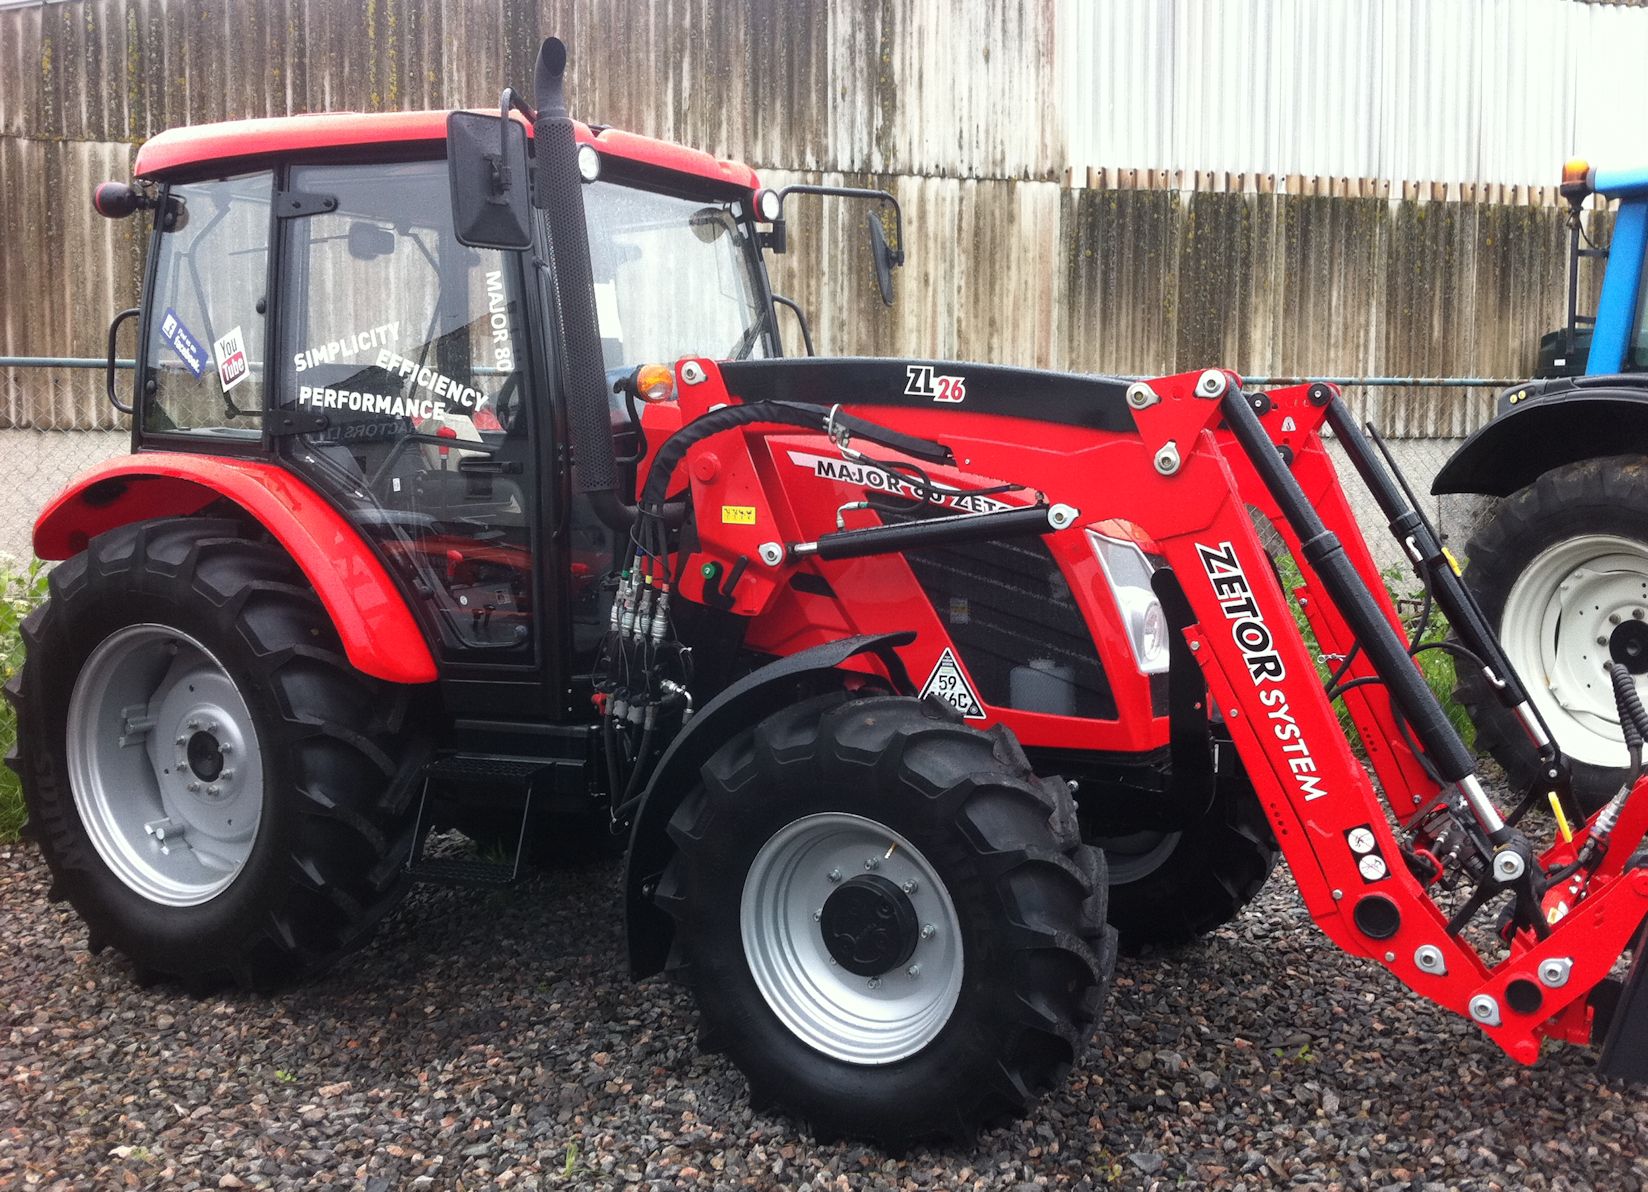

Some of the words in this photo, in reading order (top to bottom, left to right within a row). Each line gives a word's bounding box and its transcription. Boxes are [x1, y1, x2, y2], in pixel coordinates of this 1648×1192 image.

[486, 270, 509, 344] MAJOR
[220, 338, 237, 358] You
[293, 321, 400, 372] SIMPLICITY
[494, 347, 513, 373] 80
[222, 357, 245, 381] Tube
[375, 347, 489, 411] EFFICIENCY
[299, 386, 446, 421] PERFORMANCE
[816, 461, 903, 493] MAJOR
[939, 675, 957, 691] 59
[1194, 541, 1286, 686] ZETOR
[1259, 689, 1328, 802] SYSTEM
